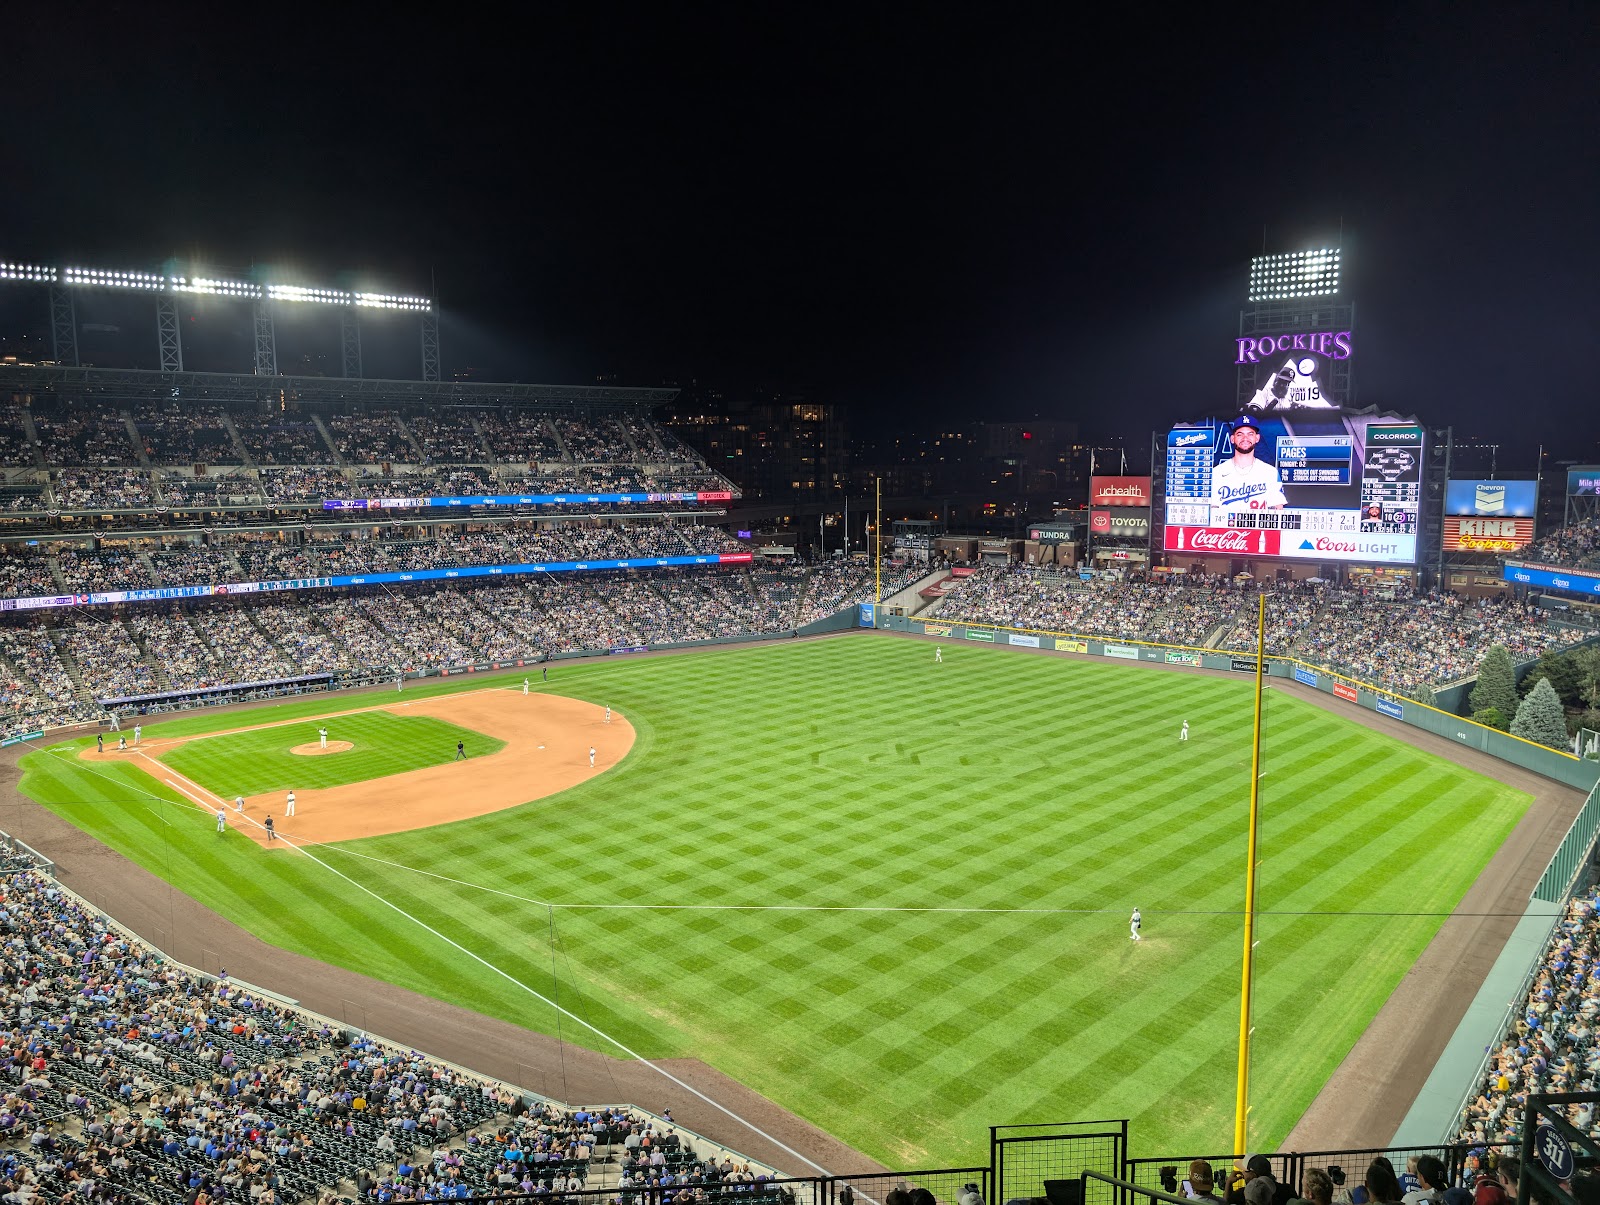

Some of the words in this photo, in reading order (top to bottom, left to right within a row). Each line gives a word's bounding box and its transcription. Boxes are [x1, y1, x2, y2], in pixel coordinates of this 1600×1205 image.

[1234, 331, 1352, 364] ROCKIES
[1290, 392, 1306, 401] YOU
[1308, 387, 1320, 400] 19
[1280, 447, 1306, 458] PAGES
[1099, 485, 1142, 496] uchealth
[1218, 482, 1268, 503] Dodgers
[1110, 518, 1148, 527] TOYOTA
[1458, 520, 1516, 537] KING
[1039, 532, 1070, 540] TUNDRA
[1191, 528, 1248, 550] Coca-Cola
[1458, 534, 1516, 550] Soopers
[1316, 536, 1356, 552] Coors
[1358, 543, 1398, 554] LIGHT
[1378, 702, 1398, 714] Southwest
[1456, 732, 1466, 740] 415
[1547, 1130, 1566, 1150] SECTION
[1543, 1136, 1564, 1170] 311
